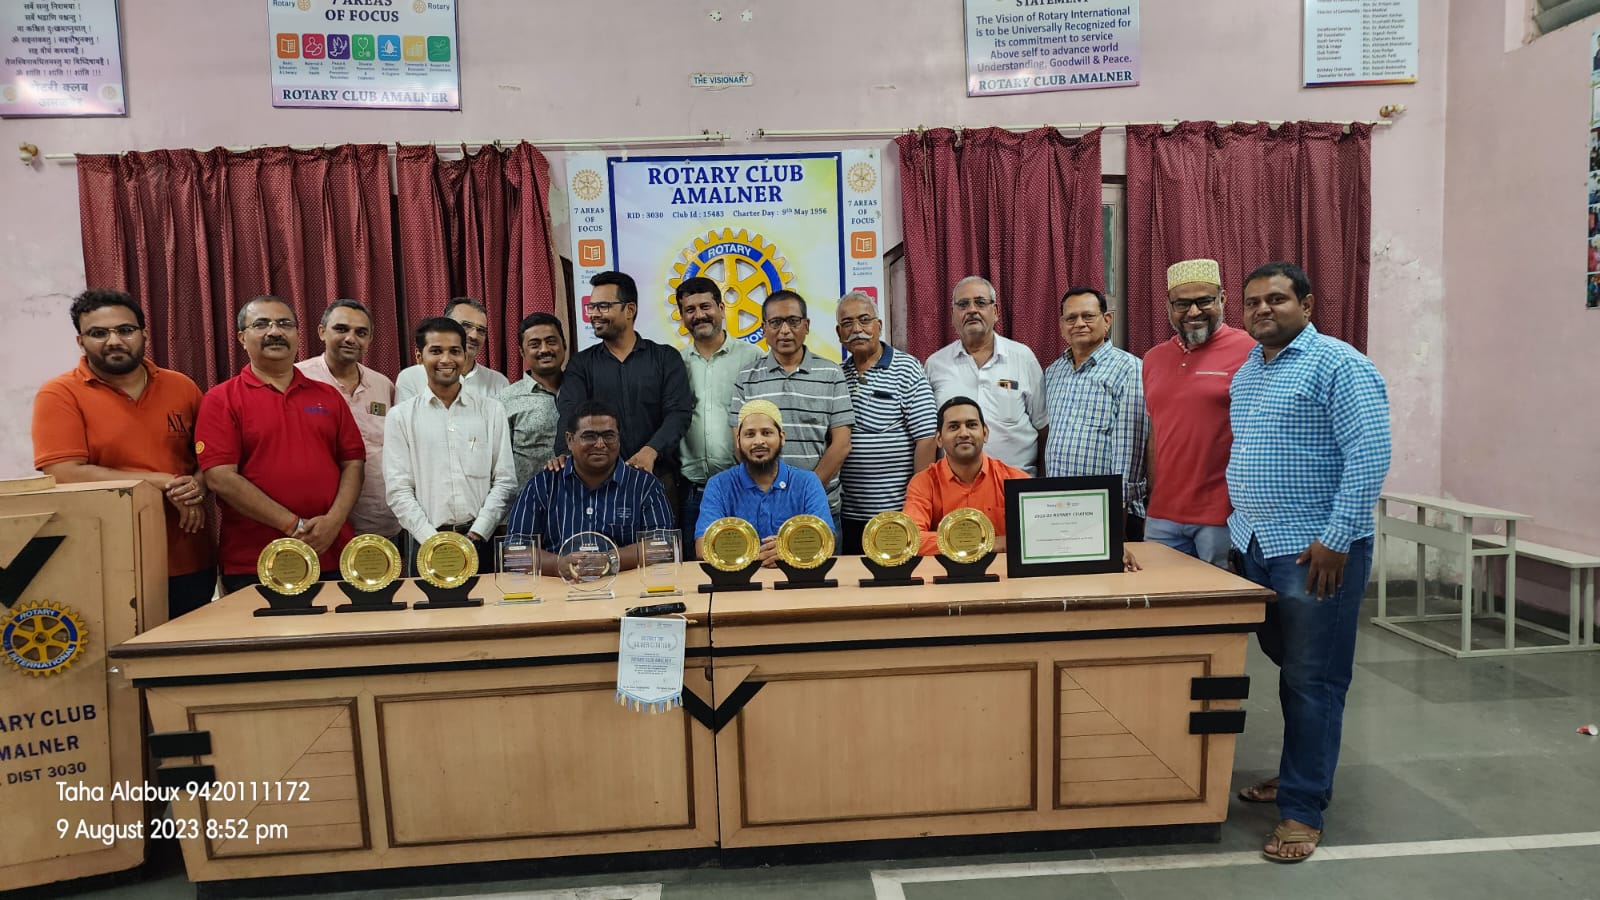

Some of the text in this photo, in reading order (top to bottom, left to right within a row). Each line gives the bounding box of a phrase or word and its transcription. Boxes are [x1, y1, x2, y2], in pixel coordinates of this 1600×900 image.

[325, 10, 399, 22] OF FOCUS
[976, 6, 1130, 24] The Vision of Rotary International
[976, 19, 1131, 36] is to be Universally Recognized for
[995, 32, 1113, 47] its commitment to service
[990, 42, 1119, 59] Above self to advance world
[1050, 55, 1090, 67] Goodwill
[1093, 55, 1100, 65] &
[1103, 54, 1132, 64] Peace.
[979, 71, 1132, 90] ROTARY CLUB AMALNER
[283, 90, 448, 103] ROTARY CLUB AMALNER
[648, 164, 804, 184] ROTARY CLUB
[671, 186, 783, 205] AMALNER
[762, 209, 774, 217] Day
[707, 243, 751, 258] ROTARY
[20, 608, 55, 620] ROTARY
[8, 645, 76, 669] INTERNATIONAL
[40, 704, 96, 726] CLUB
[0, 735, 79, 761] MALNER
[7, 762, 86, 784] DIST 3030
